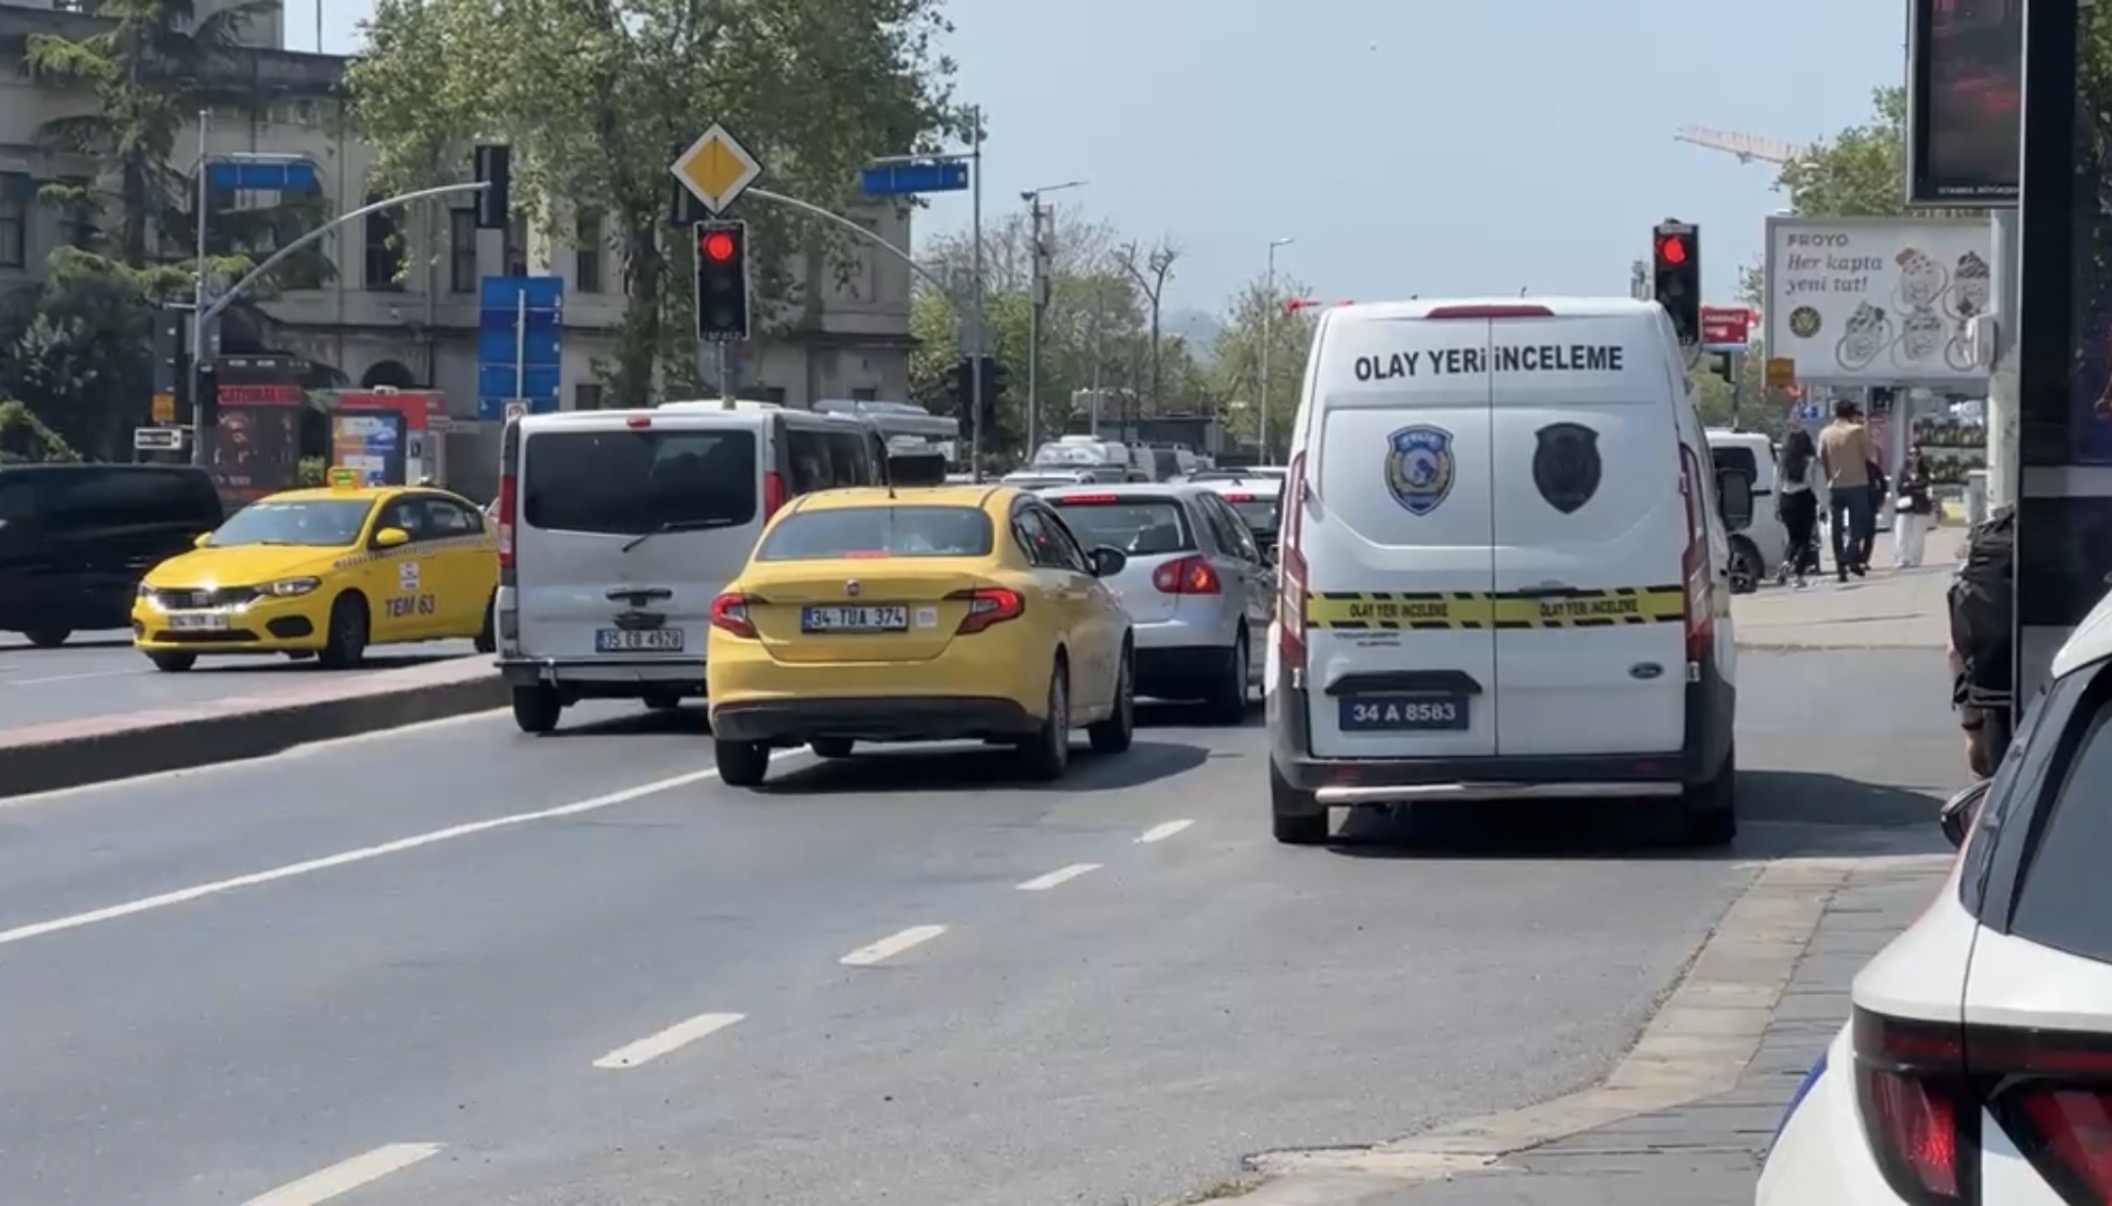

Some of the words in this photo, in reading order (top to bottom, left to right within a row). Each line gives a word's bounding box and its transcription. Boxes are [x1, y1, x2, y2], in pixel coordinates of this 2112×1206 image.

[1787, 233, 1849, 247] FROYO
[1787, 253, 1821, 271] Her
[1826, 253, 1883, 275] kapta
[1785, 275, 1827, 296] yeni
[1833, 275, 1869, 293] tat!
[1354, 351, 1420, 382] OLAY
[385, 596, 415, 619] TEM
[419, 593, 435, 616] 63
[811, 605, 832, 626] 34
[838, 605, 868, 625] TUA
[874, 605, 904, 624] 374
[1353, 703, 1379, 722] 34
[1384, 703, 1400, 721] A
[1405, 702, 1457, 721] 8583
